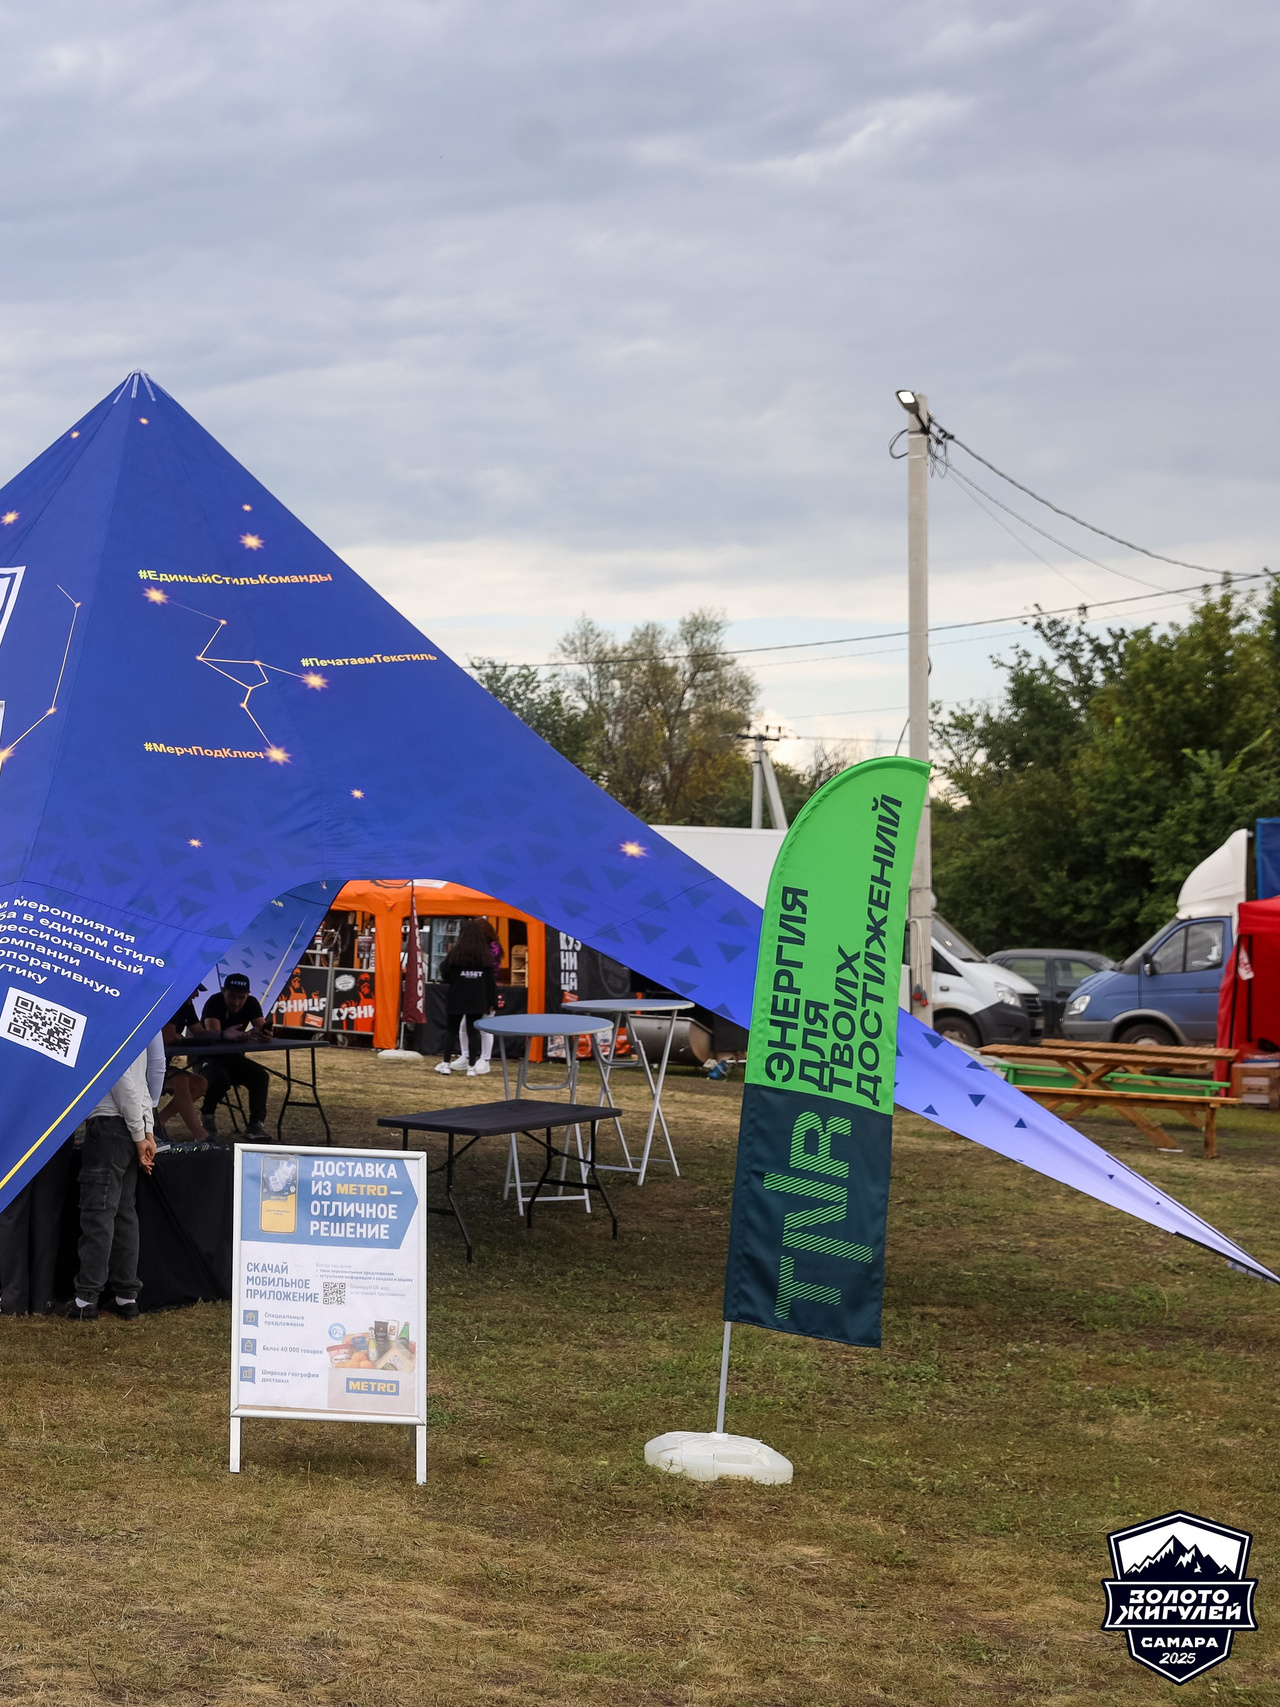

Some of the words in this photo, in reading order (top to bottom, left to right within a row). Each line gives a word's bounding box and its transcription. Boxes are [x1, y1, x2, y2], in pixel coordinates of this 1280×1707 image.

[138, 569, 333, 586] #ЕдиныйСтильКоманды
[300, 652, 438, 668] #ПечатаемТекстиль
[144, 742, 265, 760] #МерчПодКлюч
[13, 898, 136, 944] мероприятия
[39, 918, 109, 948] едином
[113, 944, 166, 968] стиле
[856, 794, 903, 1107] ДОСТИЖЕНИЙ
[561, 951, 578, 970] НИ
[561, 972, 578, 991] ЦА
[765, 885, 809, 1083] ЭНЕРГИЯ
[828, 944, 861, 1092] ТВОИХ
[798, 999, 830, 1092] ДЛЯ
[311, 1160, 398, 1179] ДОСТАВКА
[311, 1180, 332, 1196] ИЗ
[336, 1183, 388, 1196] METRO
[310, 1200, 398, 1219] ОТЛИЧНОЕ
[763, 1111, 873, 1319] TNR
[309, 1221, 390, 1240] РЕШЕНИЕ
[246, 1261, 289, 1275] СКАЧАЙ
[246, 1275, 311, 1289] МОБИЛЬНОЕ
[245, 1289, 320, 1303] ПРИЛОЖЕНИЕ
[264, 1312, 305, 1320] Специальные
[261, 1369, 287, 1377] Широкая
[287, 1371, 320, 1379] география
[348, 1380, 397, 1393] METRO
